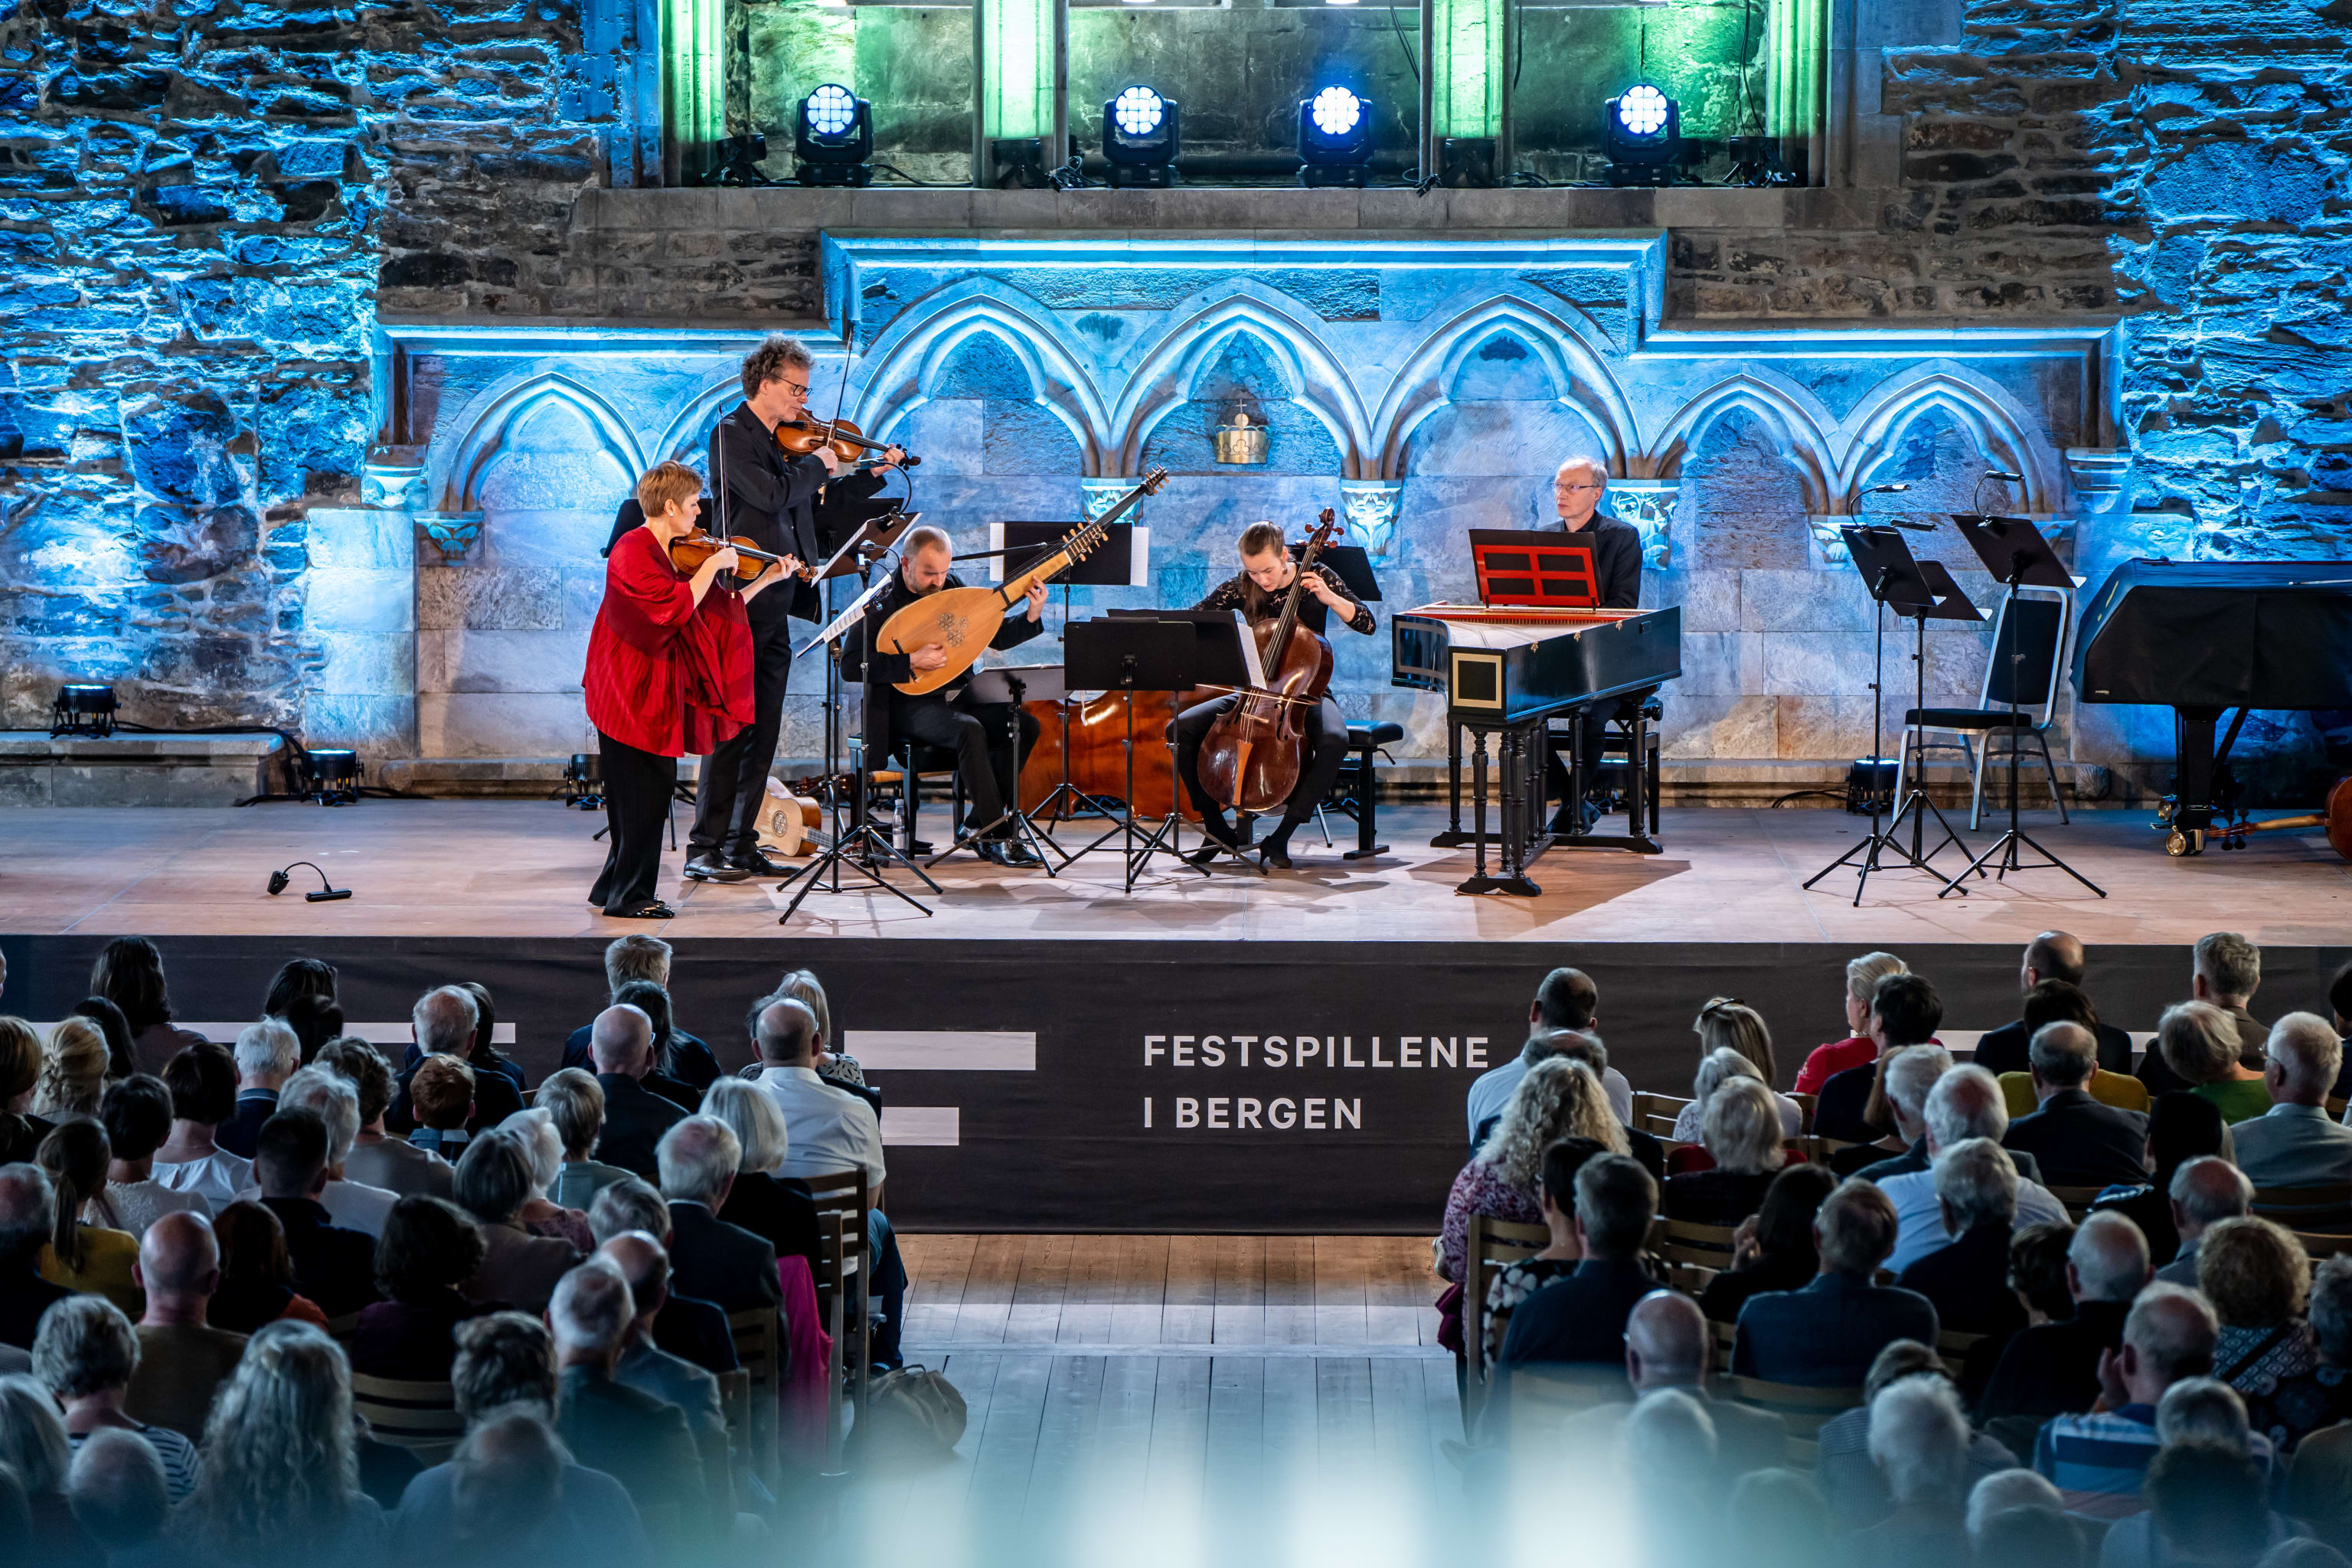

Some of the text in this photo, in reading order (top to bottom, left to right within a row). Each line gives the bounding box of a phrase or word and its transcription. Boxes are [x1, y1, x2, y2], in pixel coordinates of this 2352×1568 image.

[1145, 1035, 1489, 1069] FESTSPILLENE
[1144, 1097, 1361, 1129] I BERGEN
